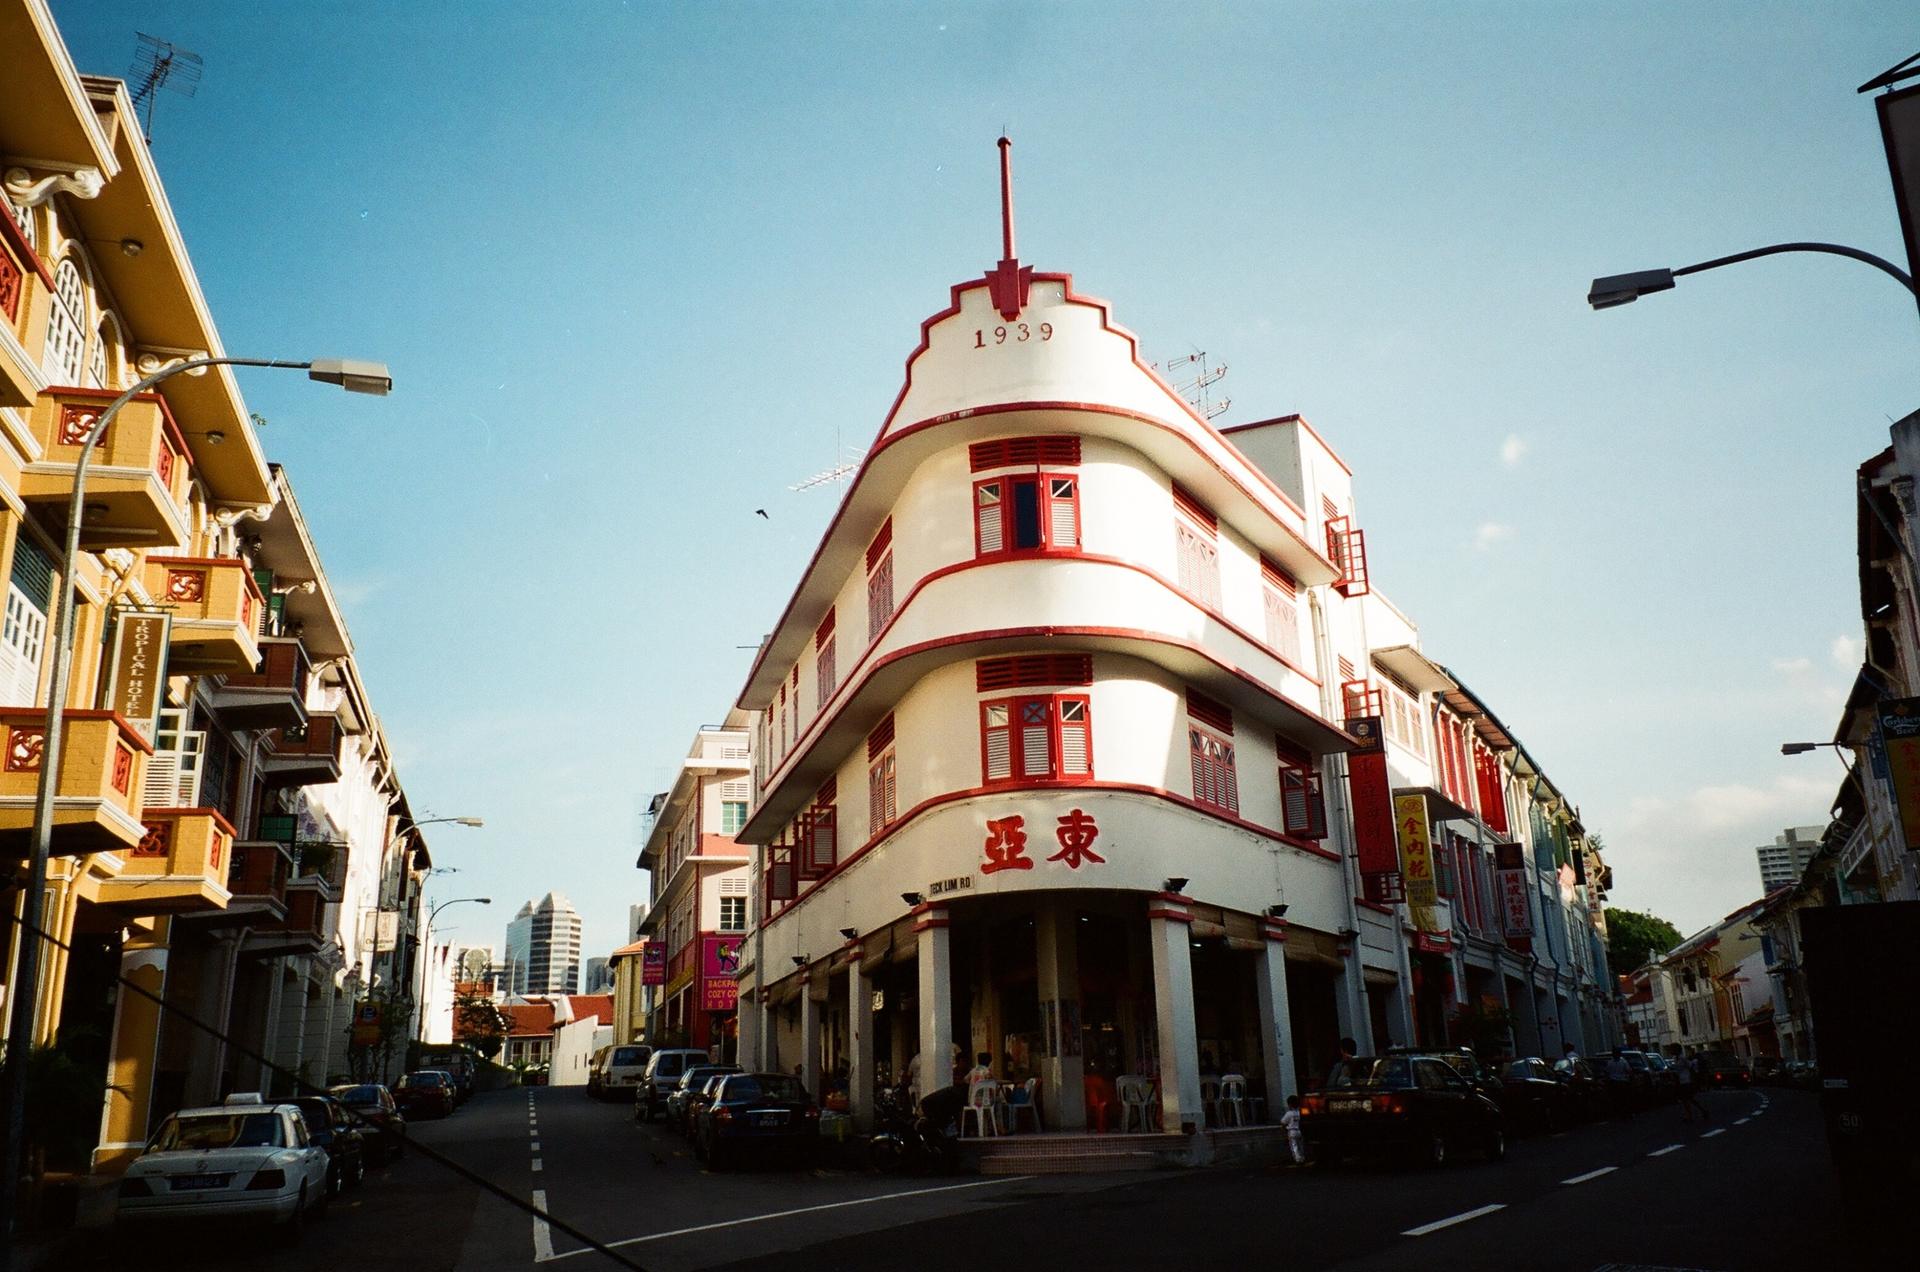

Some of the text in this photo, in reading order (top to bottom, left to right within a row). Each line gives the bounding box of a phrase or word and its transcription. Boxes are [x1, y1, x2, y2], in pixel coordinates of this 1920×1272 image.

[974, 322, 1053, 349] 1939
[130, 619, 151, 676] TROPICAL
[125, 680, 143, 717] HOTEL
[930, 876, 971, 896] TECK LIM RD
